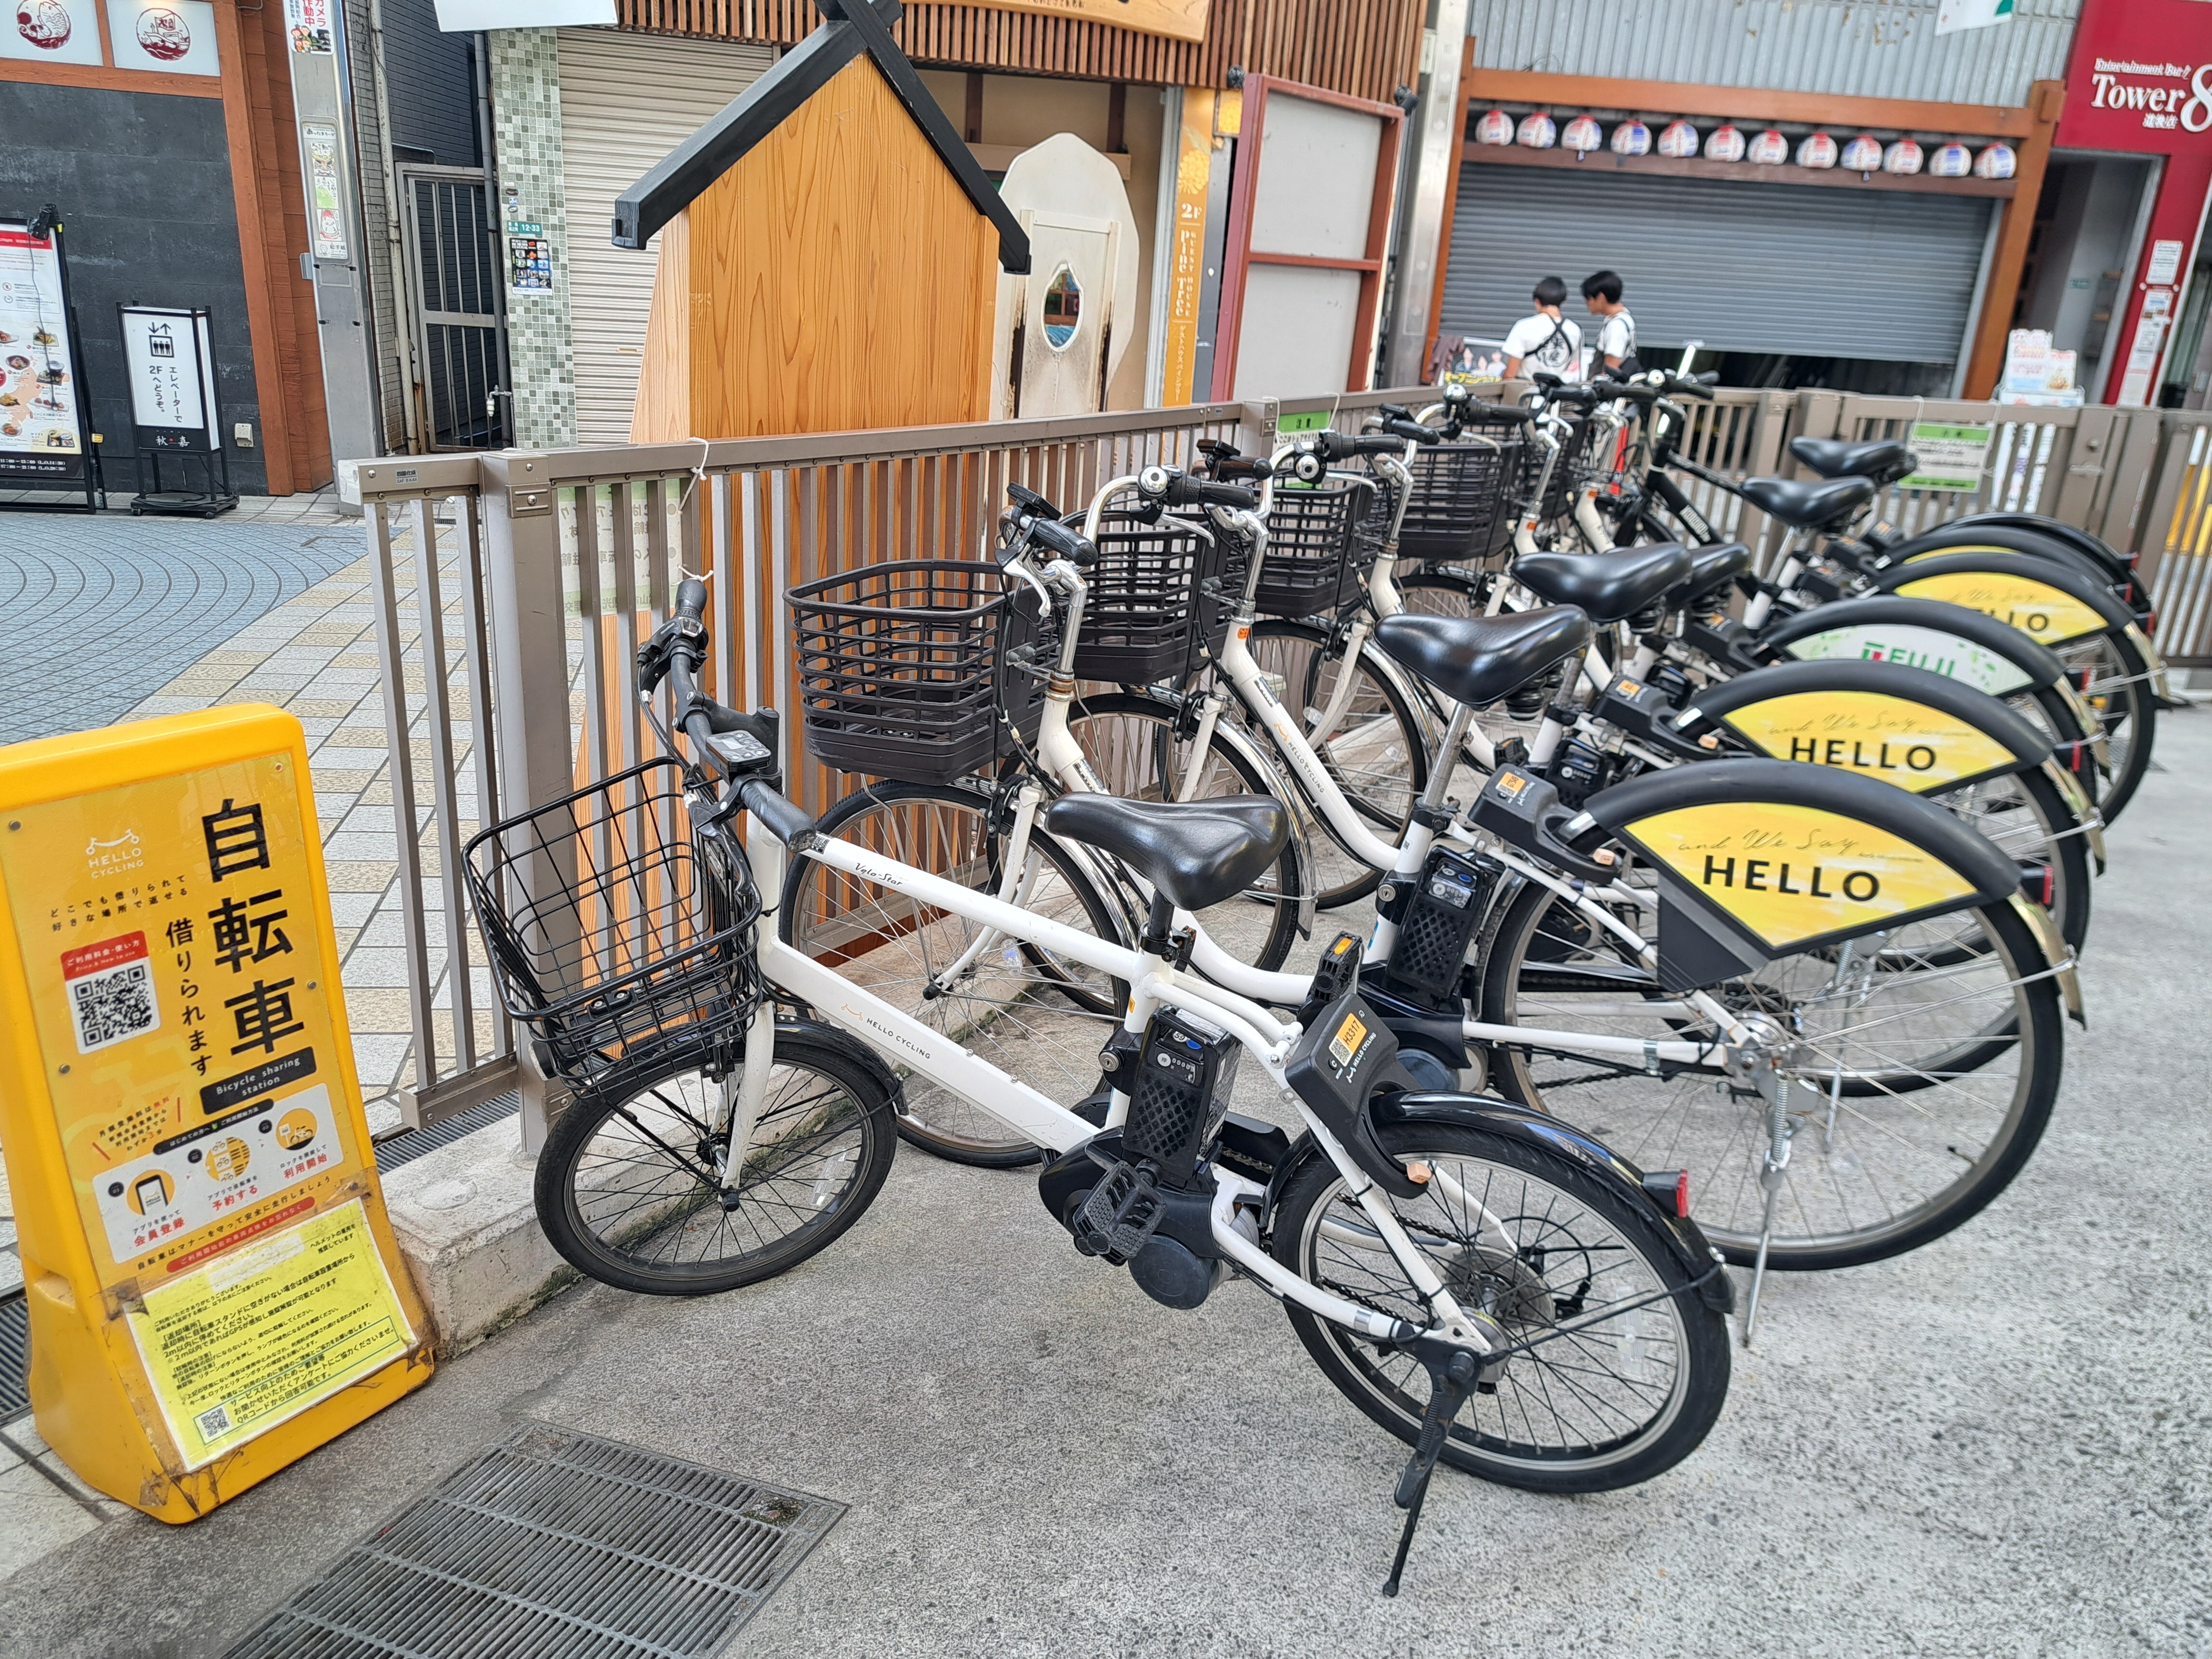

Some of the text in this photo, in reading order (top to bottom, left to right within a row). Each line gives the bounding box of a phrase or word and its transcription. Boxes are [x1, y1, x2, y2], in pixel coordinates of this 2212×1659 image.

[2091, 74, 2186, 112] Tower
[521, 224, 540, 232] 12-33
[1181, 203, 1202, 219] 2F
[1175, 230, 1190, 317] Pine Tree
[169, 366, 183, 423] エレベーターで
[1288, 742, 1325, 794] HELLO CYCLING
[1791, 737, 1936, 771] HELLO
[88, 848, 142, 869] HELLO
[1796, 829, 1862, 856] Say
[91, 859, 144, 879] CYCLING
[856, 863, 904, 886] Velo-Star
[1703, 855, 1880, 902] HELLO
[51, 875, 186, 918] どこでも借りられて
[53, 888, 187, 932] 好きな場所で返せる
[202, 798, 305, 1055] 自転車
[165, 917, 212, 1076] 借りられます
[866, 1018, 931, 1059] HELLO CYCLING
[1343, 1019, 1360, 1046] H3317
[1352, 1032, 1377, 1068] HELLO CYCLING
[216, 1057, 301, 1095] Bicycle sharing
[242, 1076, 280, 1096] station
[284, 1153, 327, 1180] 利用開始
[208, 1175, 258, 1201] アプリで自転車を
[212, 1184, 258, 1211] 予約する
[133, 1209, 180, 1235] アプリを使って
[134, 1217, 185, 1247] 会員登録
[137, 1176, 330, 1271] 自転車はマナーを守って安全に走行しましょう
[237, 1372, 332, 1424] QRコードから回答可能です。
